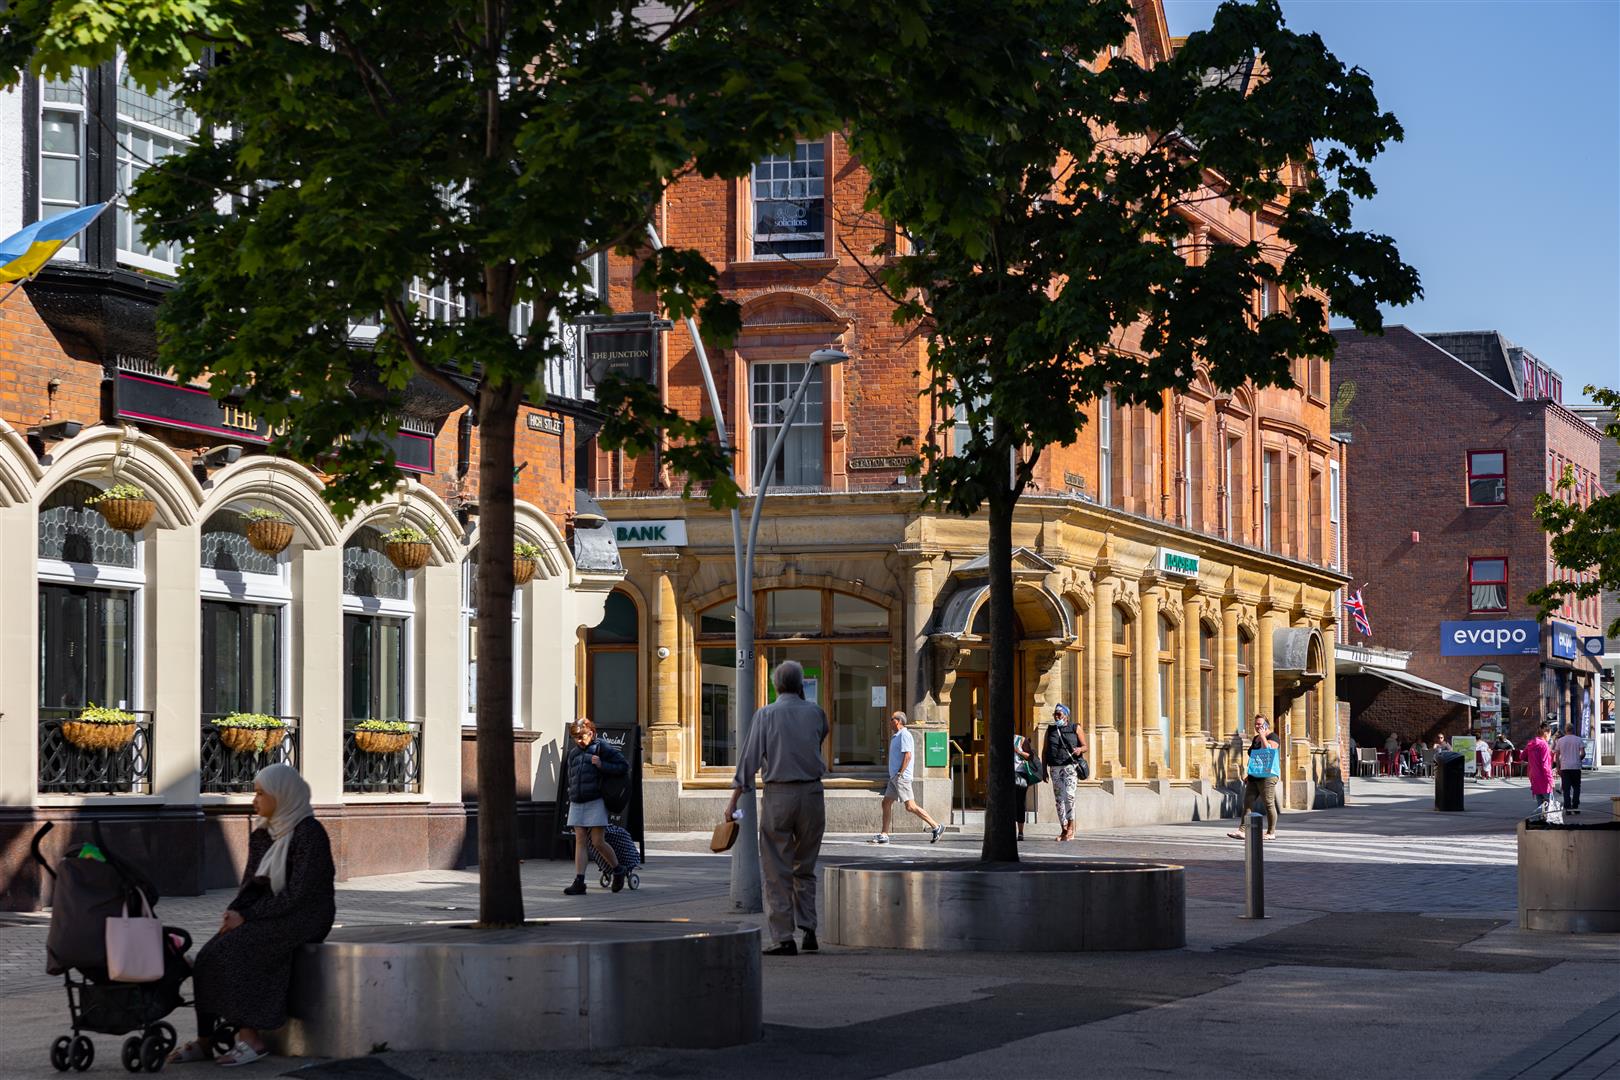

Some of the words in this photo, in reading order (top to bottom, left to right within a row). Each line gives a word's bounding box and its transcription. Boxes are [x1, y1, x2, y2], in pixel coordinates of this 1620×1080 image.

[591, 352, 607, 360] THE
[608, 350, 649, 360] JUNCTION
[616, 525, 666, 542] BANK
[1453, 628, 1527, 649] evapo
